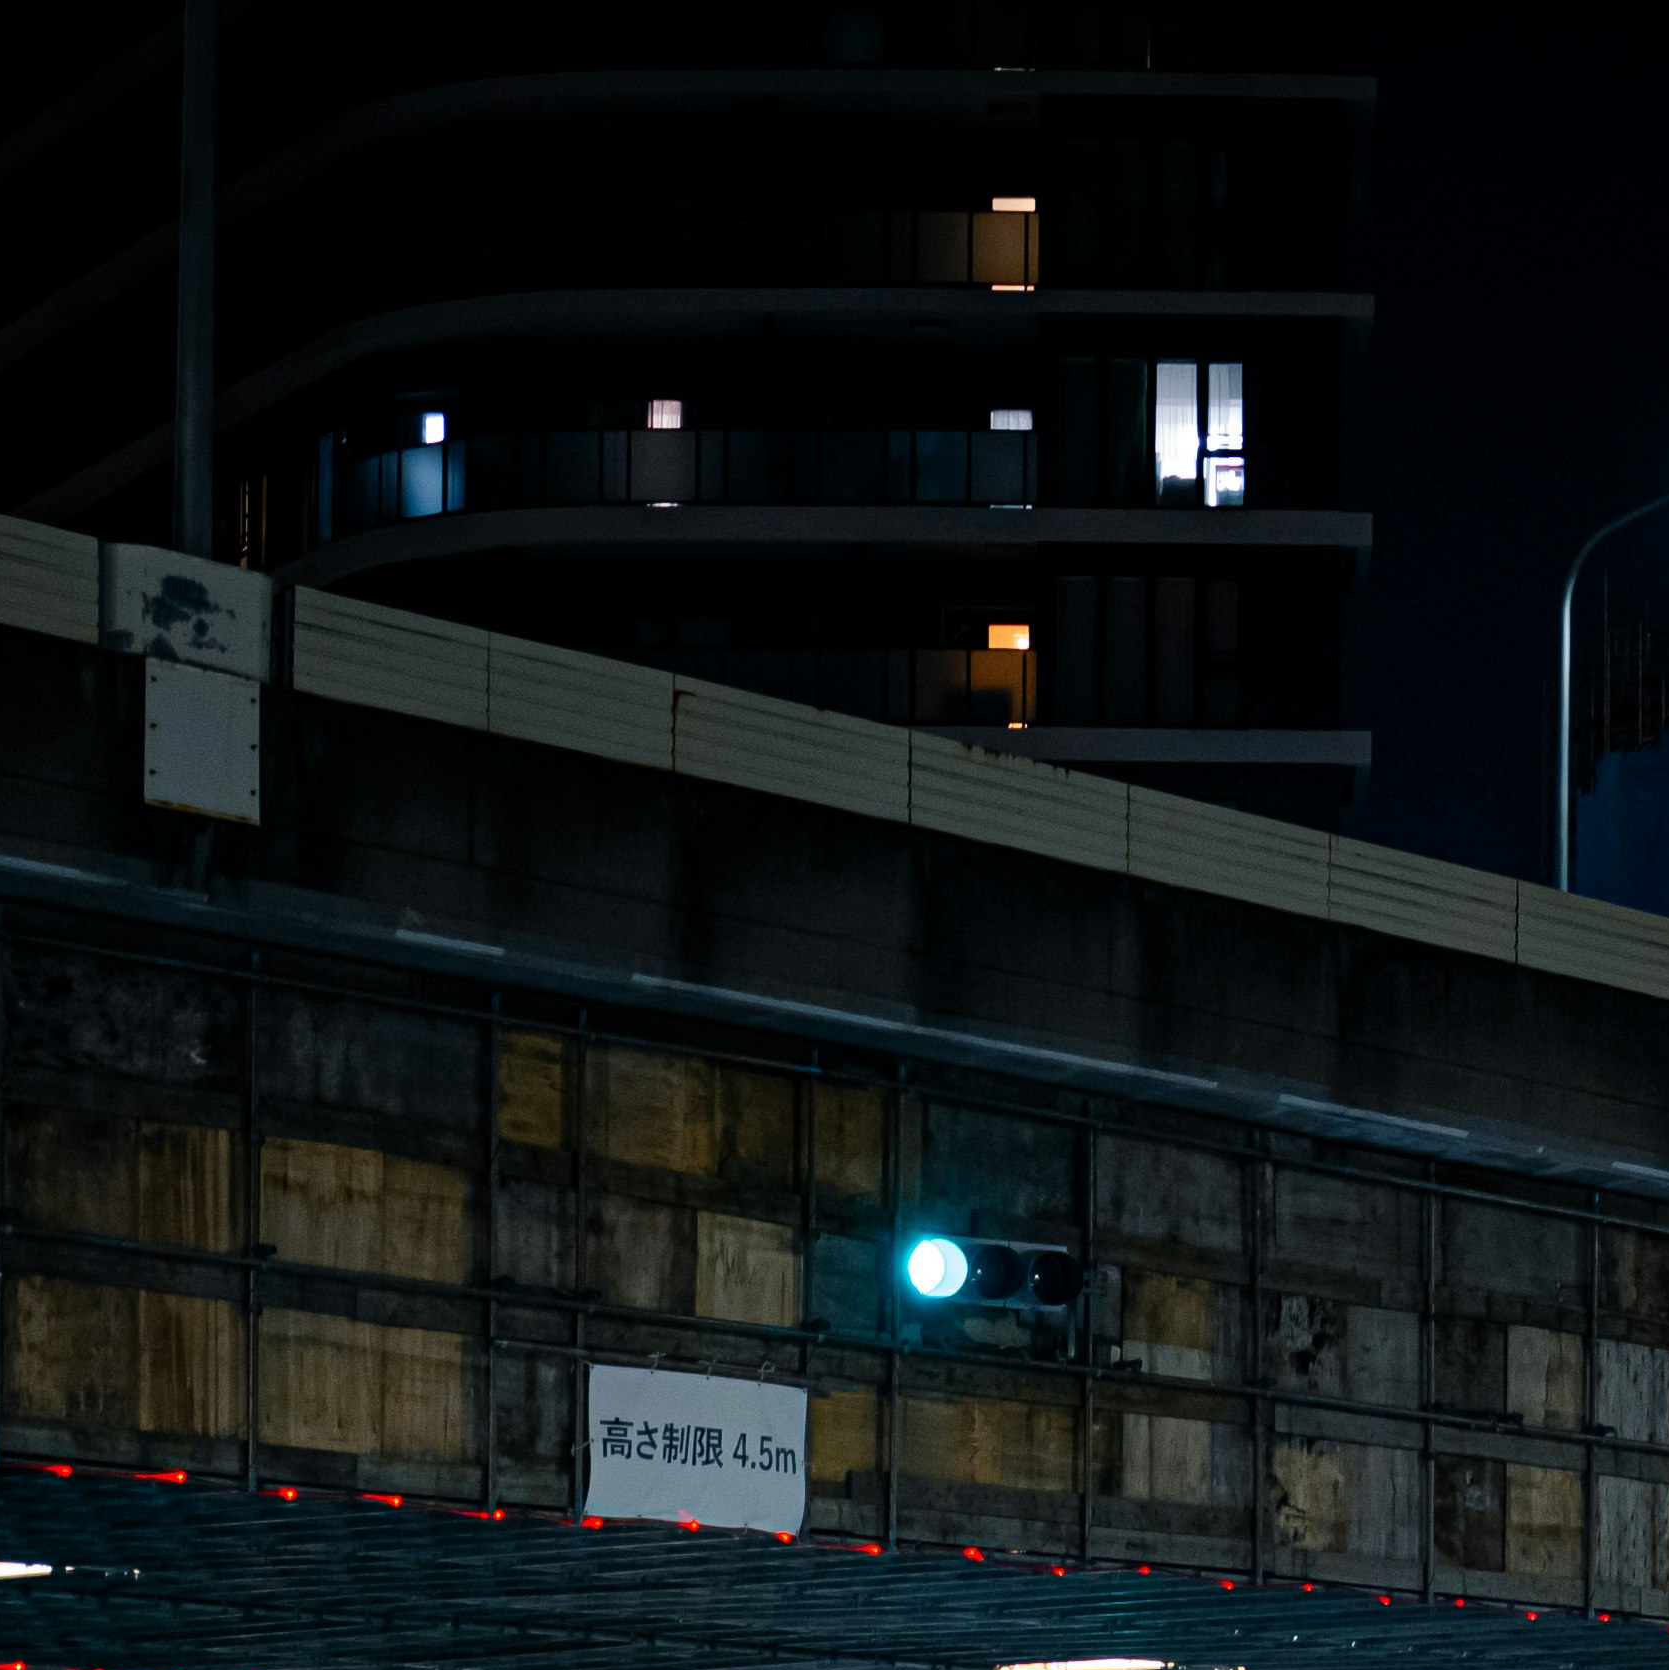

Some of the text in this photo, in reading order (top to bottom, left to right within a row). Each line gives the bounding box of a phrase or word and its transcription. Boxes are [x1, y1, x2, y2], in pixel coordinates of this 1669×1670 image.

[599, 1417, 797, 1474] 高さ制限 4.5m
